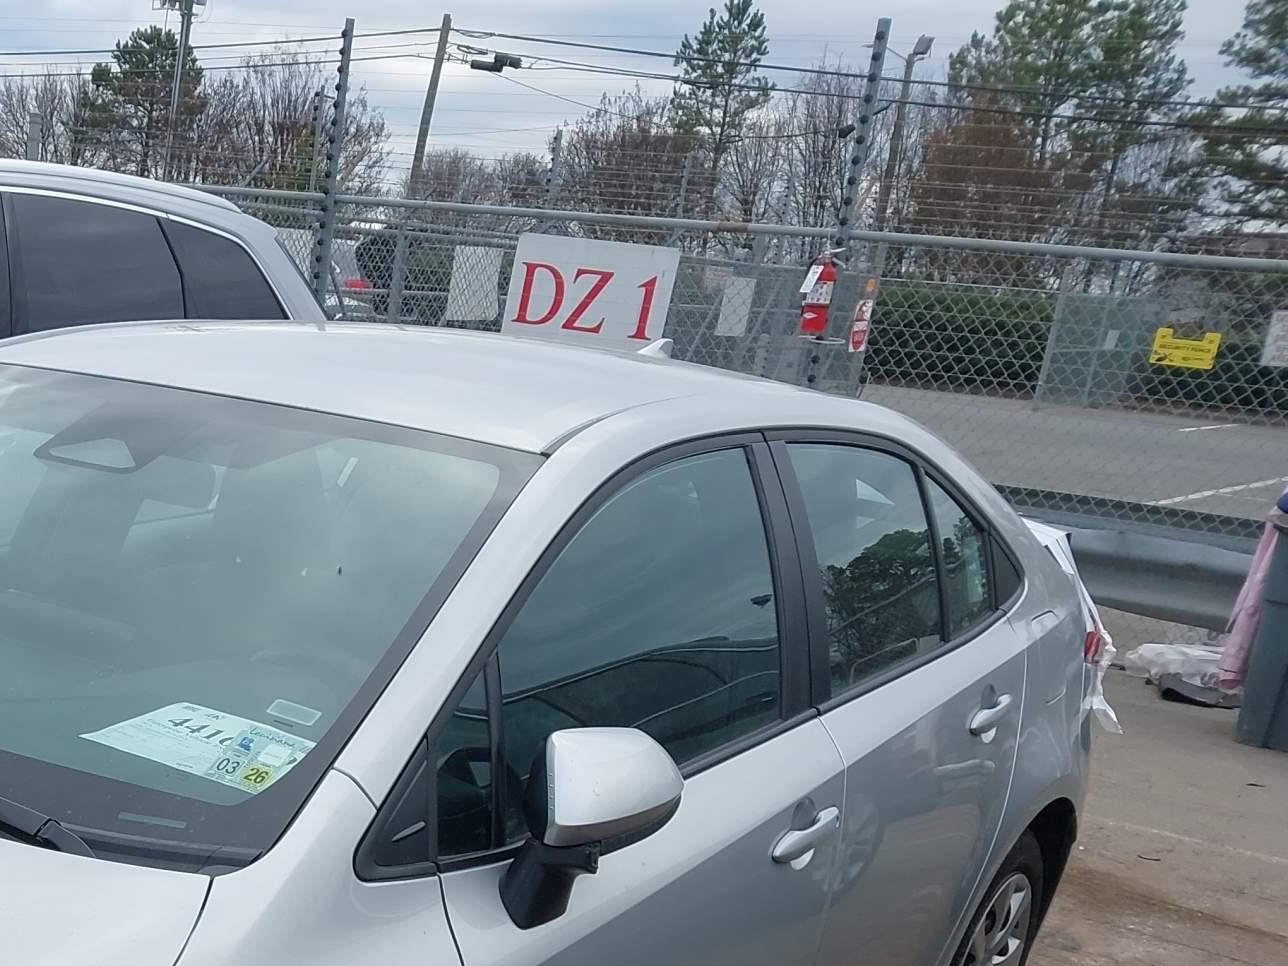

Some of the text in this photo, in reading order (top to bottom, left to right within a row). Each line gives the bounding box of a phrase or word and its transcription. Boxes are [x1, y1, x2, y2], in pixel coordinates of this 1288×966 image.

[512, 261, 659, 341] DZ 1
[216, 757, 241, 774] 03
[243, 767, 270, 785] 26
